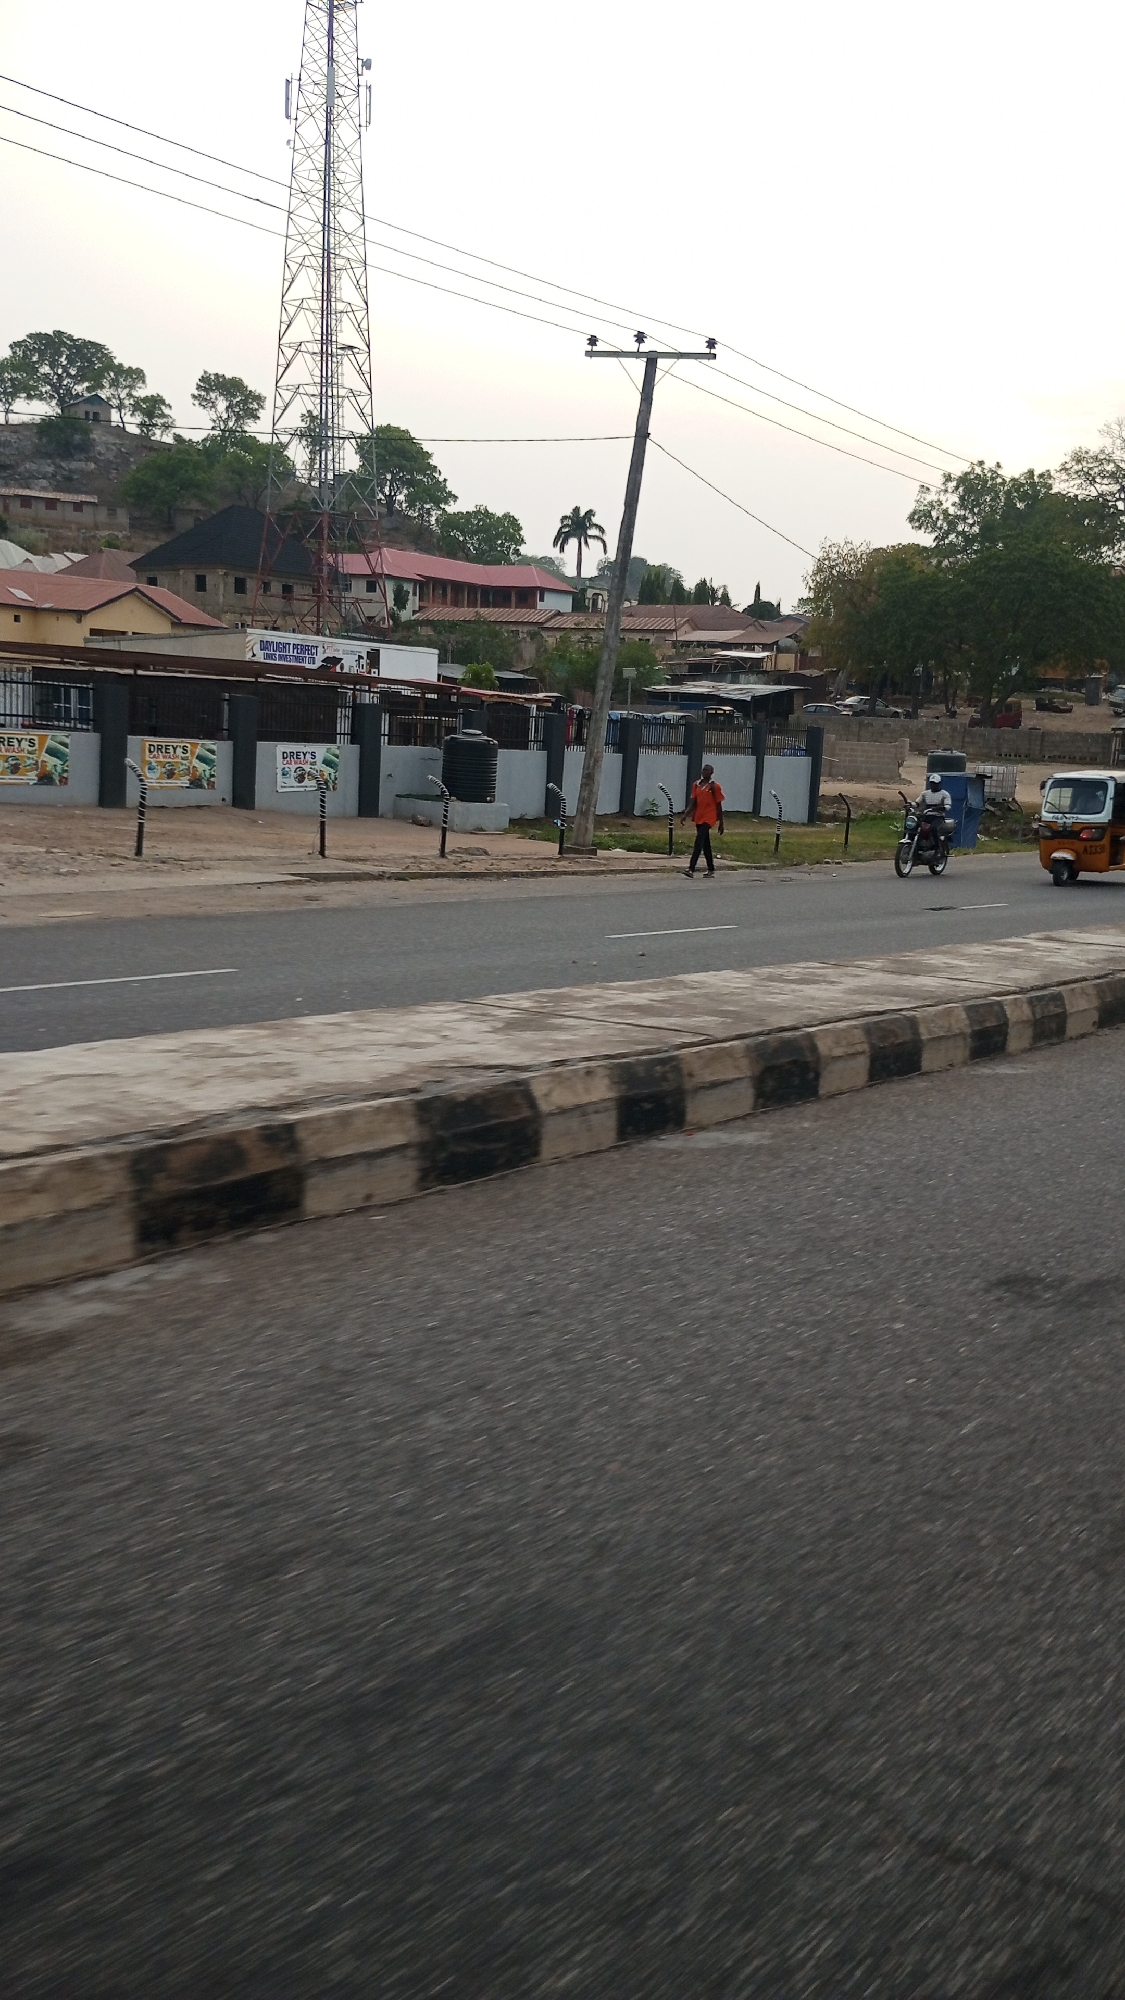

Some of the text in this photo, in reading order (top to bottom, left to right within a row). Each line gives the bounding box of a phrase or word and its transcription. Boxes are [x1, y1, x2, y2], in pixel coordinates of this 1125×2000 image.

[260, 640, 292, 654] DAYLIGHT
[293, 643, 319, 657] PERFECT
[263, 652, 278, 661] LINKS
[278, 654, 307, 665] INVESTMENT
[148, 744, 189, 755] DREY'S
[282, 751, 317, 760] DREY'S
